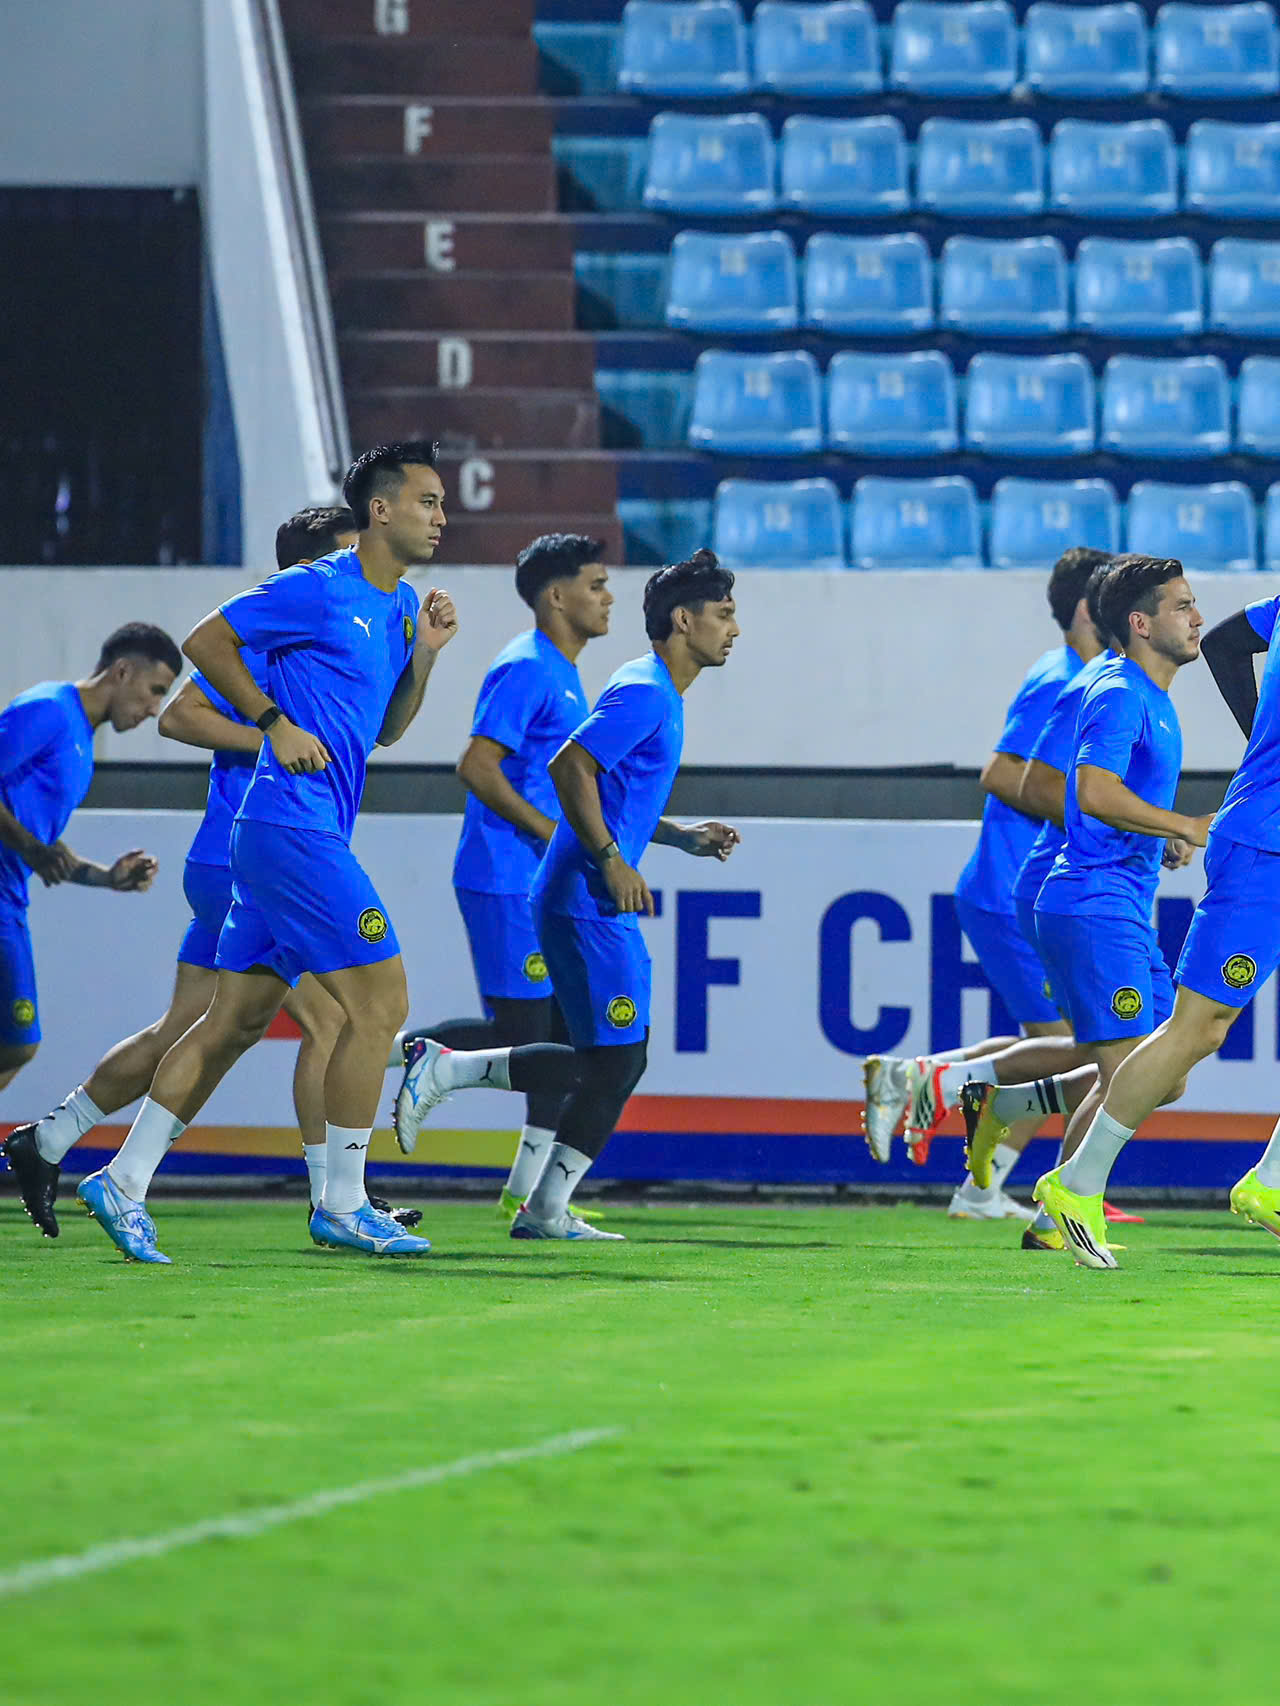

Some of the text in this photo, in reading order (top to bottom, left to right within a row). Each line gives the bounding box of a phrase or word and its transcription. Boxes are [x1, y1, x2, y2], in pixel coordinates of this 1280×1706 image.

[374, 0, 410, 35] G
[403, 105, 434, 155] F
[425, 220, 456, 272] E
[438, 337, 472, 389] D
[459, 458, 496, 512] C
